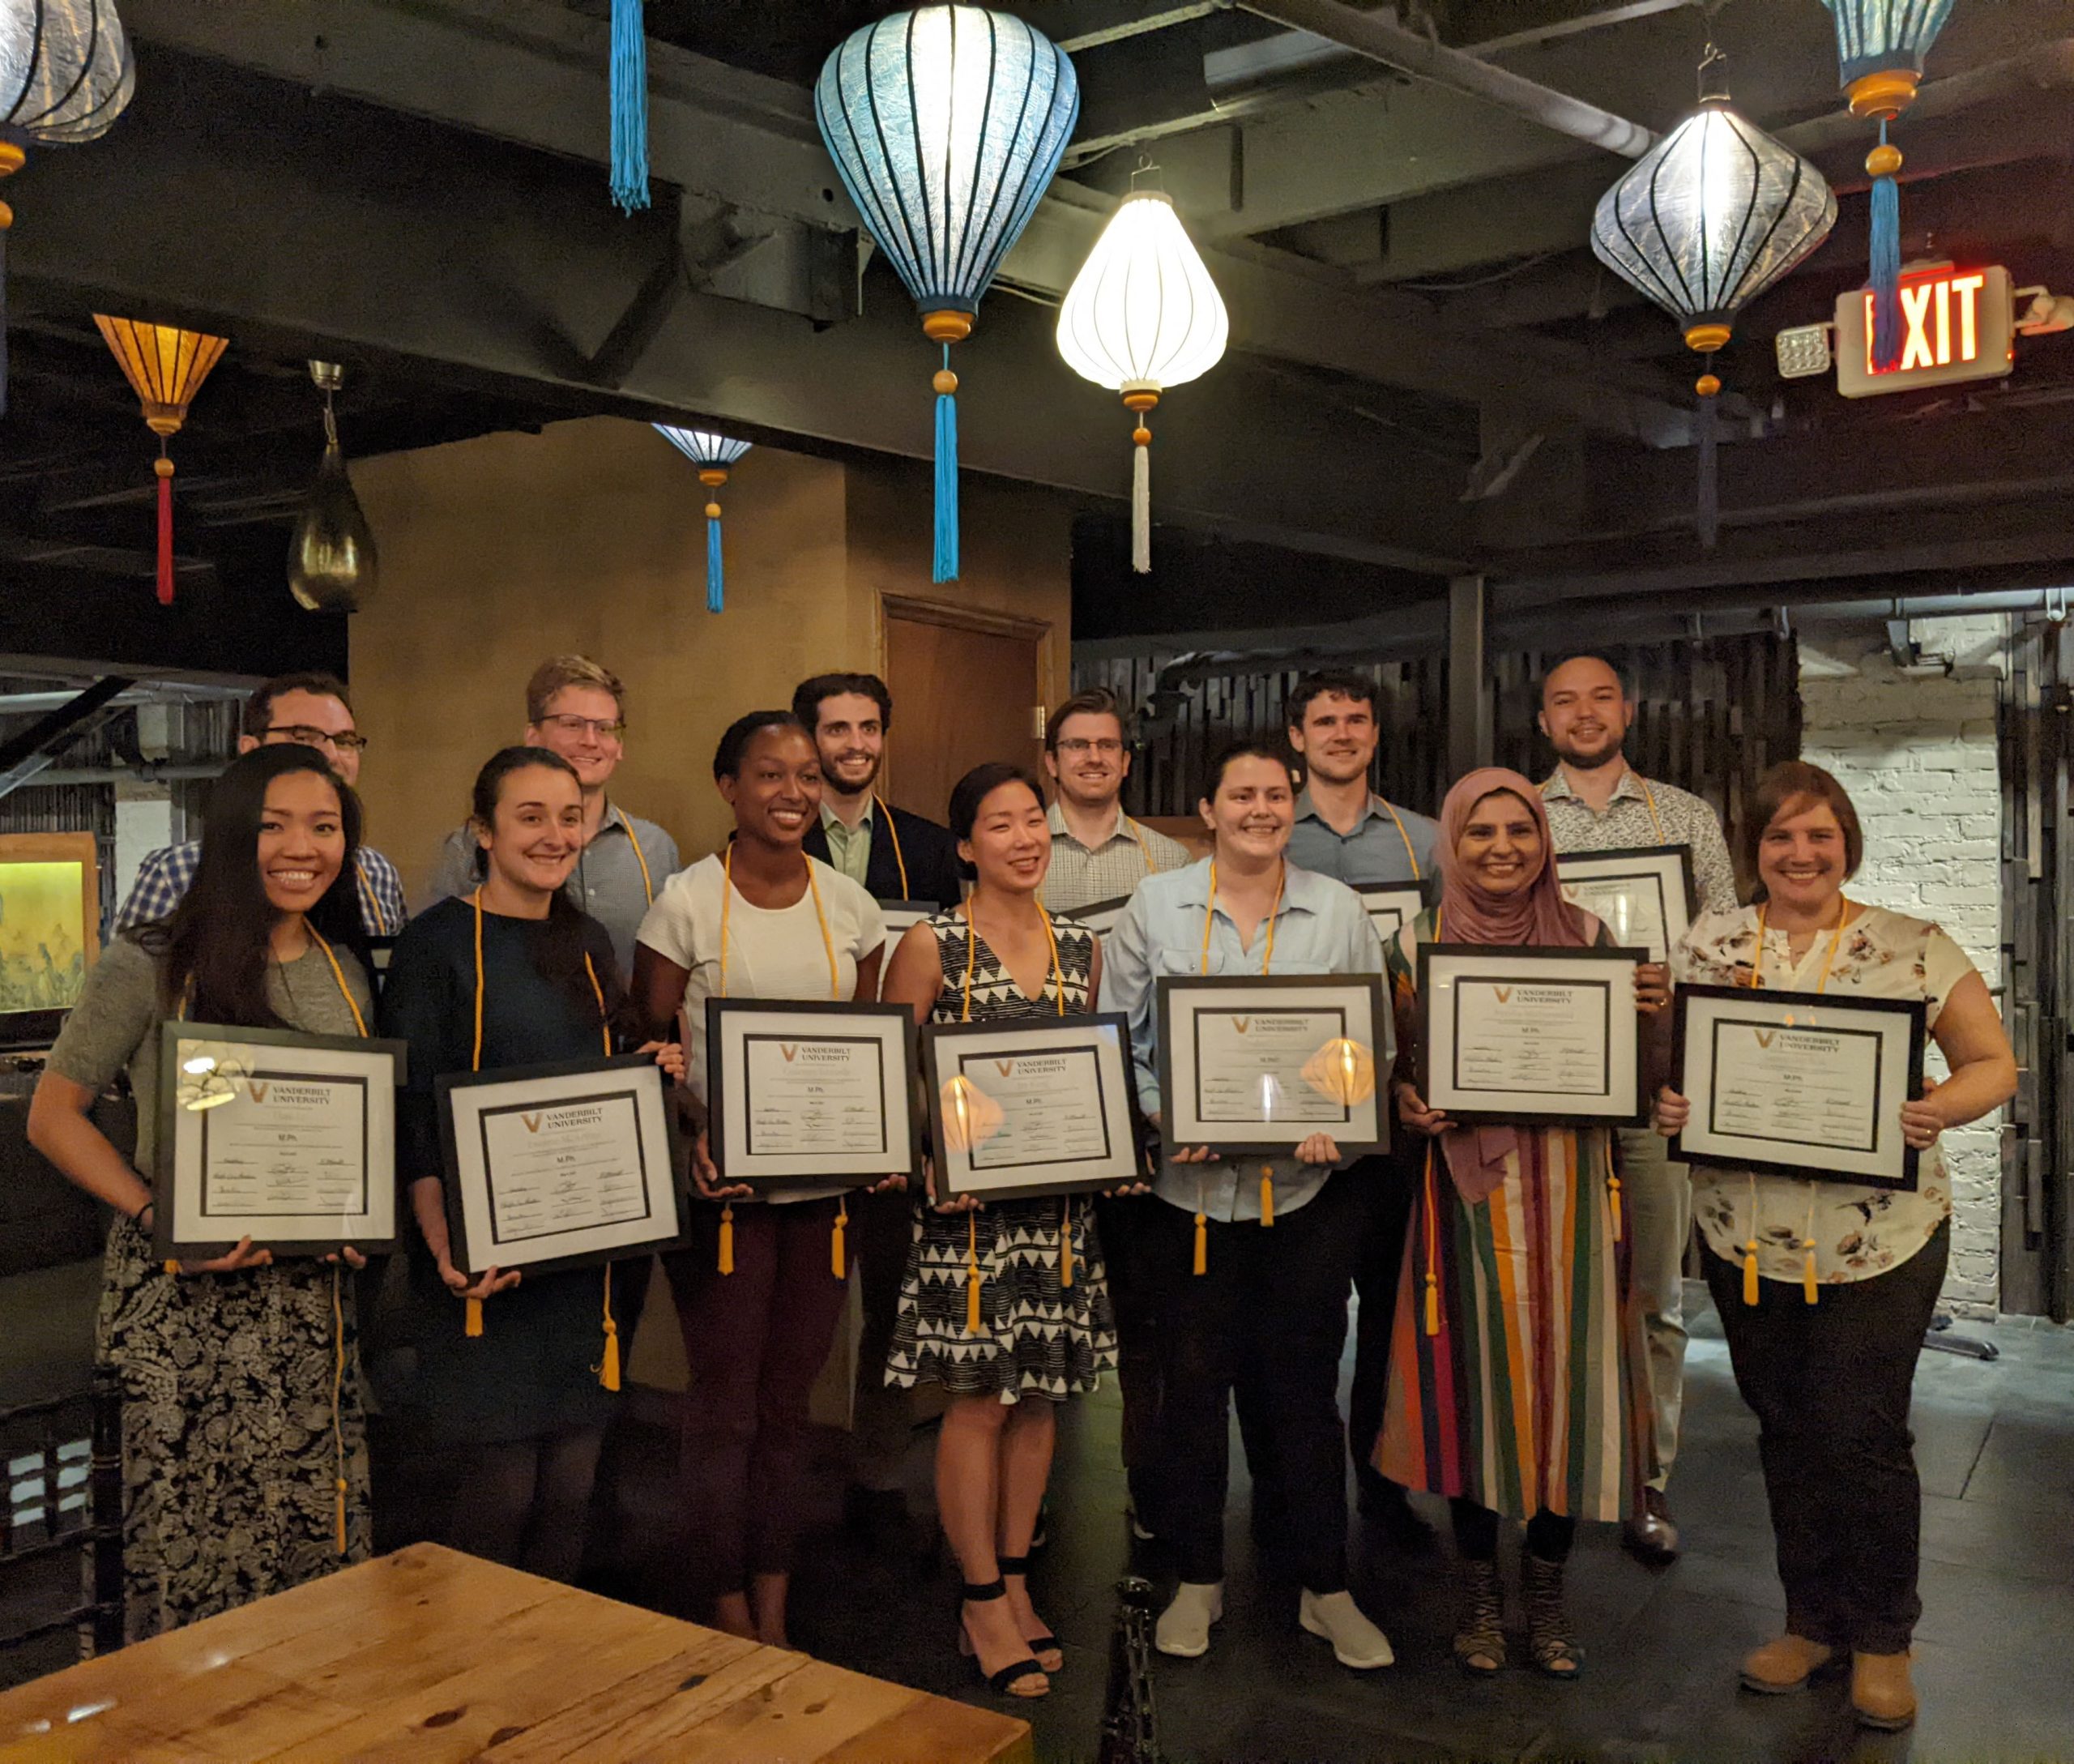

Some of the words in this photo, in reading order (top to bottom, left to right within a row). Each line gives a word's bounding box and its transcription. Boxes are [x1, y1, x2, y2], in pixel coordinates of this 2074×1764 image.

[1493, 986, 1513, 1003] V
[1517, 989, 1573, 997] VANDERBILT
[1517, 997, 1572, 1005] UNIVERSITY
[1231, 1016, 1250, 1034] V
[1754, 1029, 1776, 1049] V
[1779, 1034, 1840, 1045] VANDERBILT
[779, 1044, 799, 1062] V
[802, 1047, 851, 1055] VANDERBILT
[802, 1054, 850, 1062] UNIVERSITY
[1017, 1058, 1067, 1068] VANDERBILT
[995, 1060, 1014, 1077] V
[1018, 1066, 1067, 1074] UNIVERSITY
[248, 1081, 270, 1104] V
[273, 1087, 331, 1097] VANDERBILT
[273, 1096, 331, 1105] UNIVERSITY
[547, 1108, 603, 1121] VANDERBILT
[521, 1112, 544, 1133] V
[548, 1116, 603, 1129] UNIVERSITY
